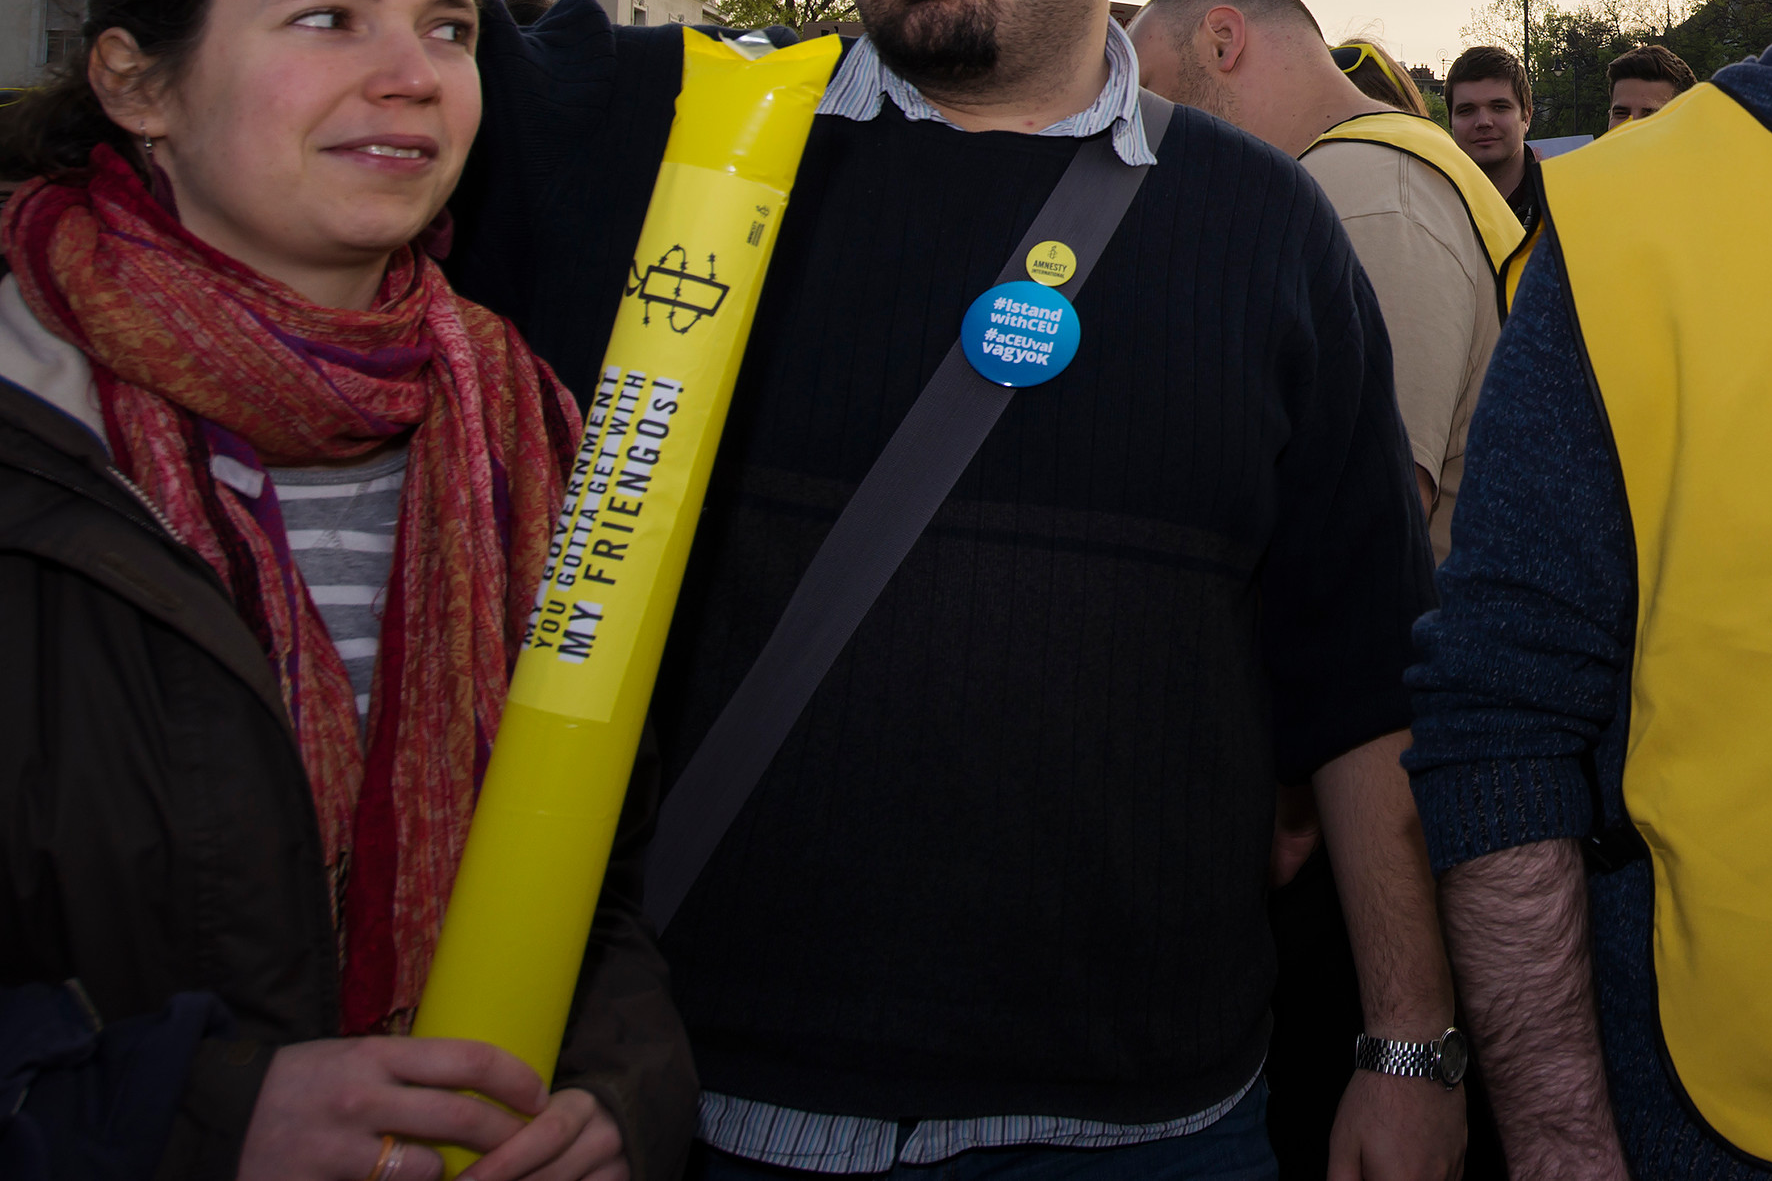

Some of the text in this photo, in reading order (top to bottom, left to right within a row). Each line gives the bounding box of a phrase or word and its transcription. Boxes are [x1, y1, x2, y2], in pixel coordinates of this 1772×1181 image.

[1033, 260, 1068, 272] AMNESTY
[993, 296, 1063, 322] #Istand
[990, 312, 1059, 335] withCEU
[982, 341, 1050, 366] vagyok
[984, 327, 1054, 354] #aCEUval
[542, 371, 619, 581] GOVERNMENT
[534, 373, 647, 649] YOU GOTTA GET WITH
[556, 603, 605, 658] MY
